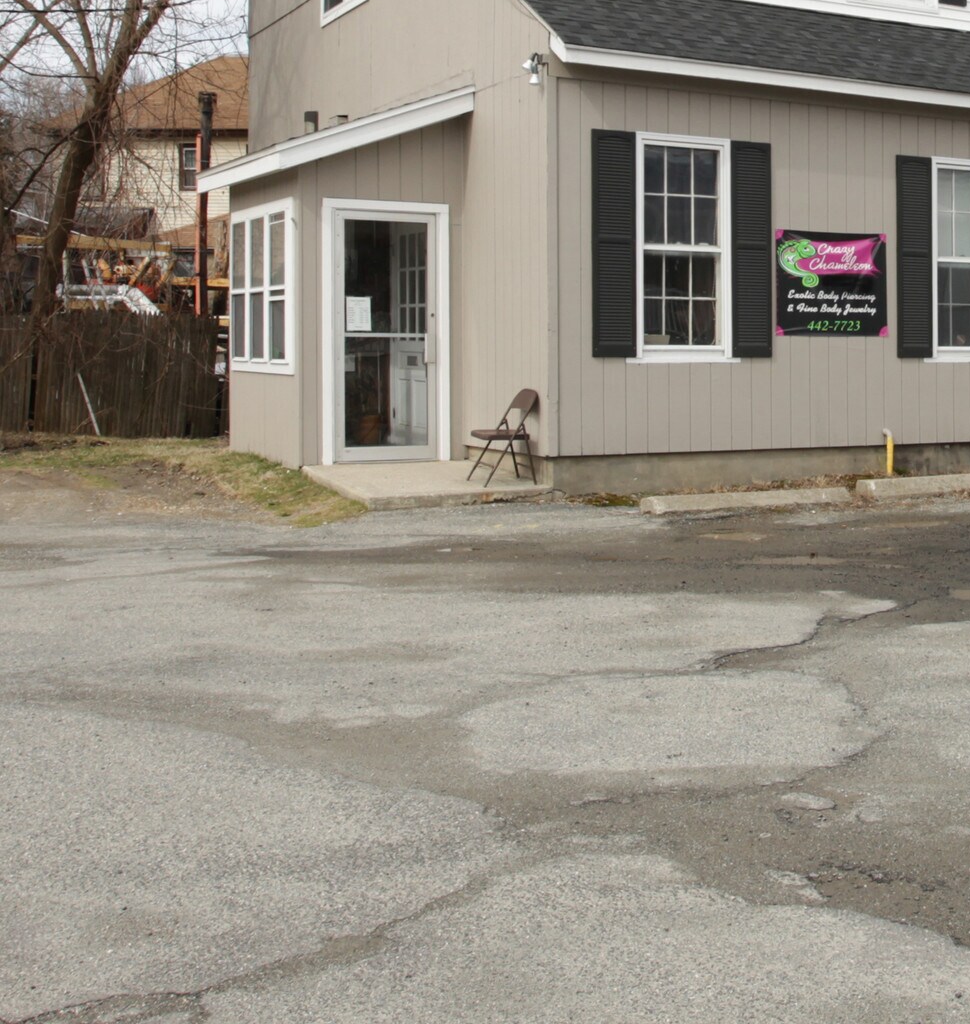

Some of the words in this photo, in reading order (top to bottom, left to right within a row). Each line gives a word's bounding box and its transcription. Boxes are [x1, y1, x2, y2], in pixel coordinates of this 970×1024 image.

[817, 243, 856, 262] Crazy
[809, 255, 873, 271] Chameleon
[787, 289, 816, 300] Exotic
[817, 290, 840, 303] Body
[841, 291, 876, 303] Piercing
[787, 304, 794, 312] &
[796, 303, 818, 313] Fine
[820, 303, 842, 316] Body
[843, 303, 877, 316] Jewelry
[807, 320, 861, 331] 442-7723
